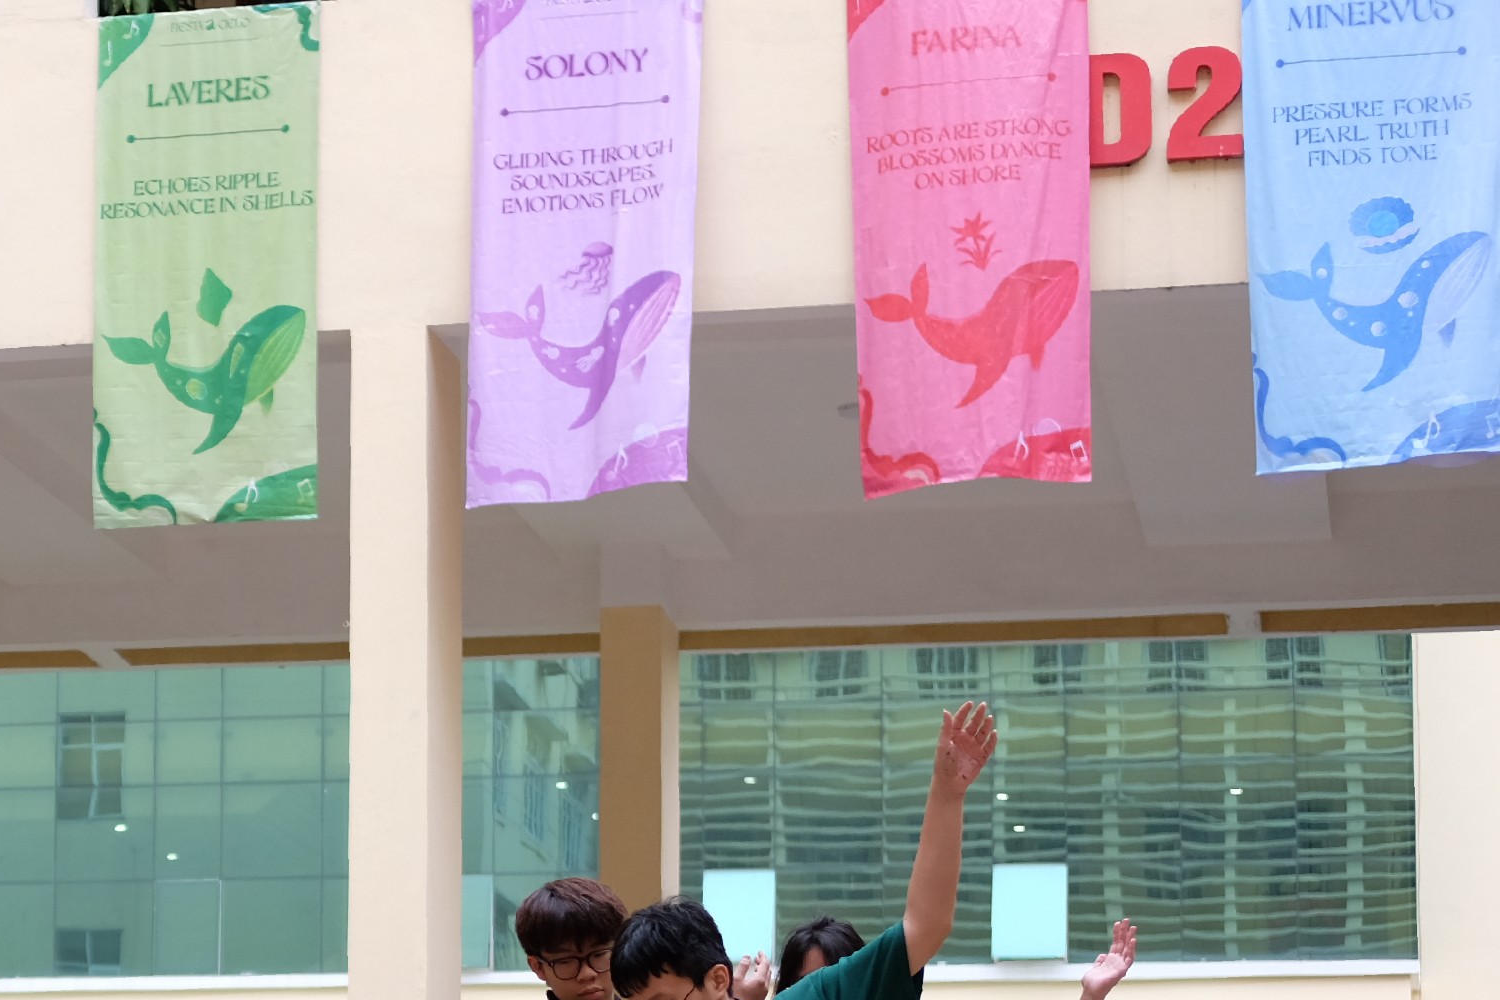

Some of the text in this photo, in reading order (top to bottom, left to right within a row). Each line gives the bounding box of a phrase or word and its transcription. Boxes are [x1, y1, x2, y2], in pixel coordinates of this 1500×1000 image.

[1287, 0, 1455, 31] MINERVUS
[911, 25, 1022, 56] FARINA
[525, 48, 648, 81] SOLONY
[147, 75, 271, 108] LAVERES
[1272, 92, 1472, 123] PRESSURE FORMS
[866, 127, 933, 154] ROOTS
[938, 122, 980, 142] ARE
[1375, 118, 1450, 141] TRUTH
[493, 138, 673, 170] GLIDING THROUGH
[877, 142, 1062, 174] BLOSSOMS DANCE
[1308, 143, 1438, 167] FINDS TONE
[133, 176, 210, 196] ECHOES
[914, 164, 1022, 190] ON SHORE
[99, 190, 314, 219] RESONANCE IN SHELLS
[502, 183, 664, 214] EMOTIONS FLOW
